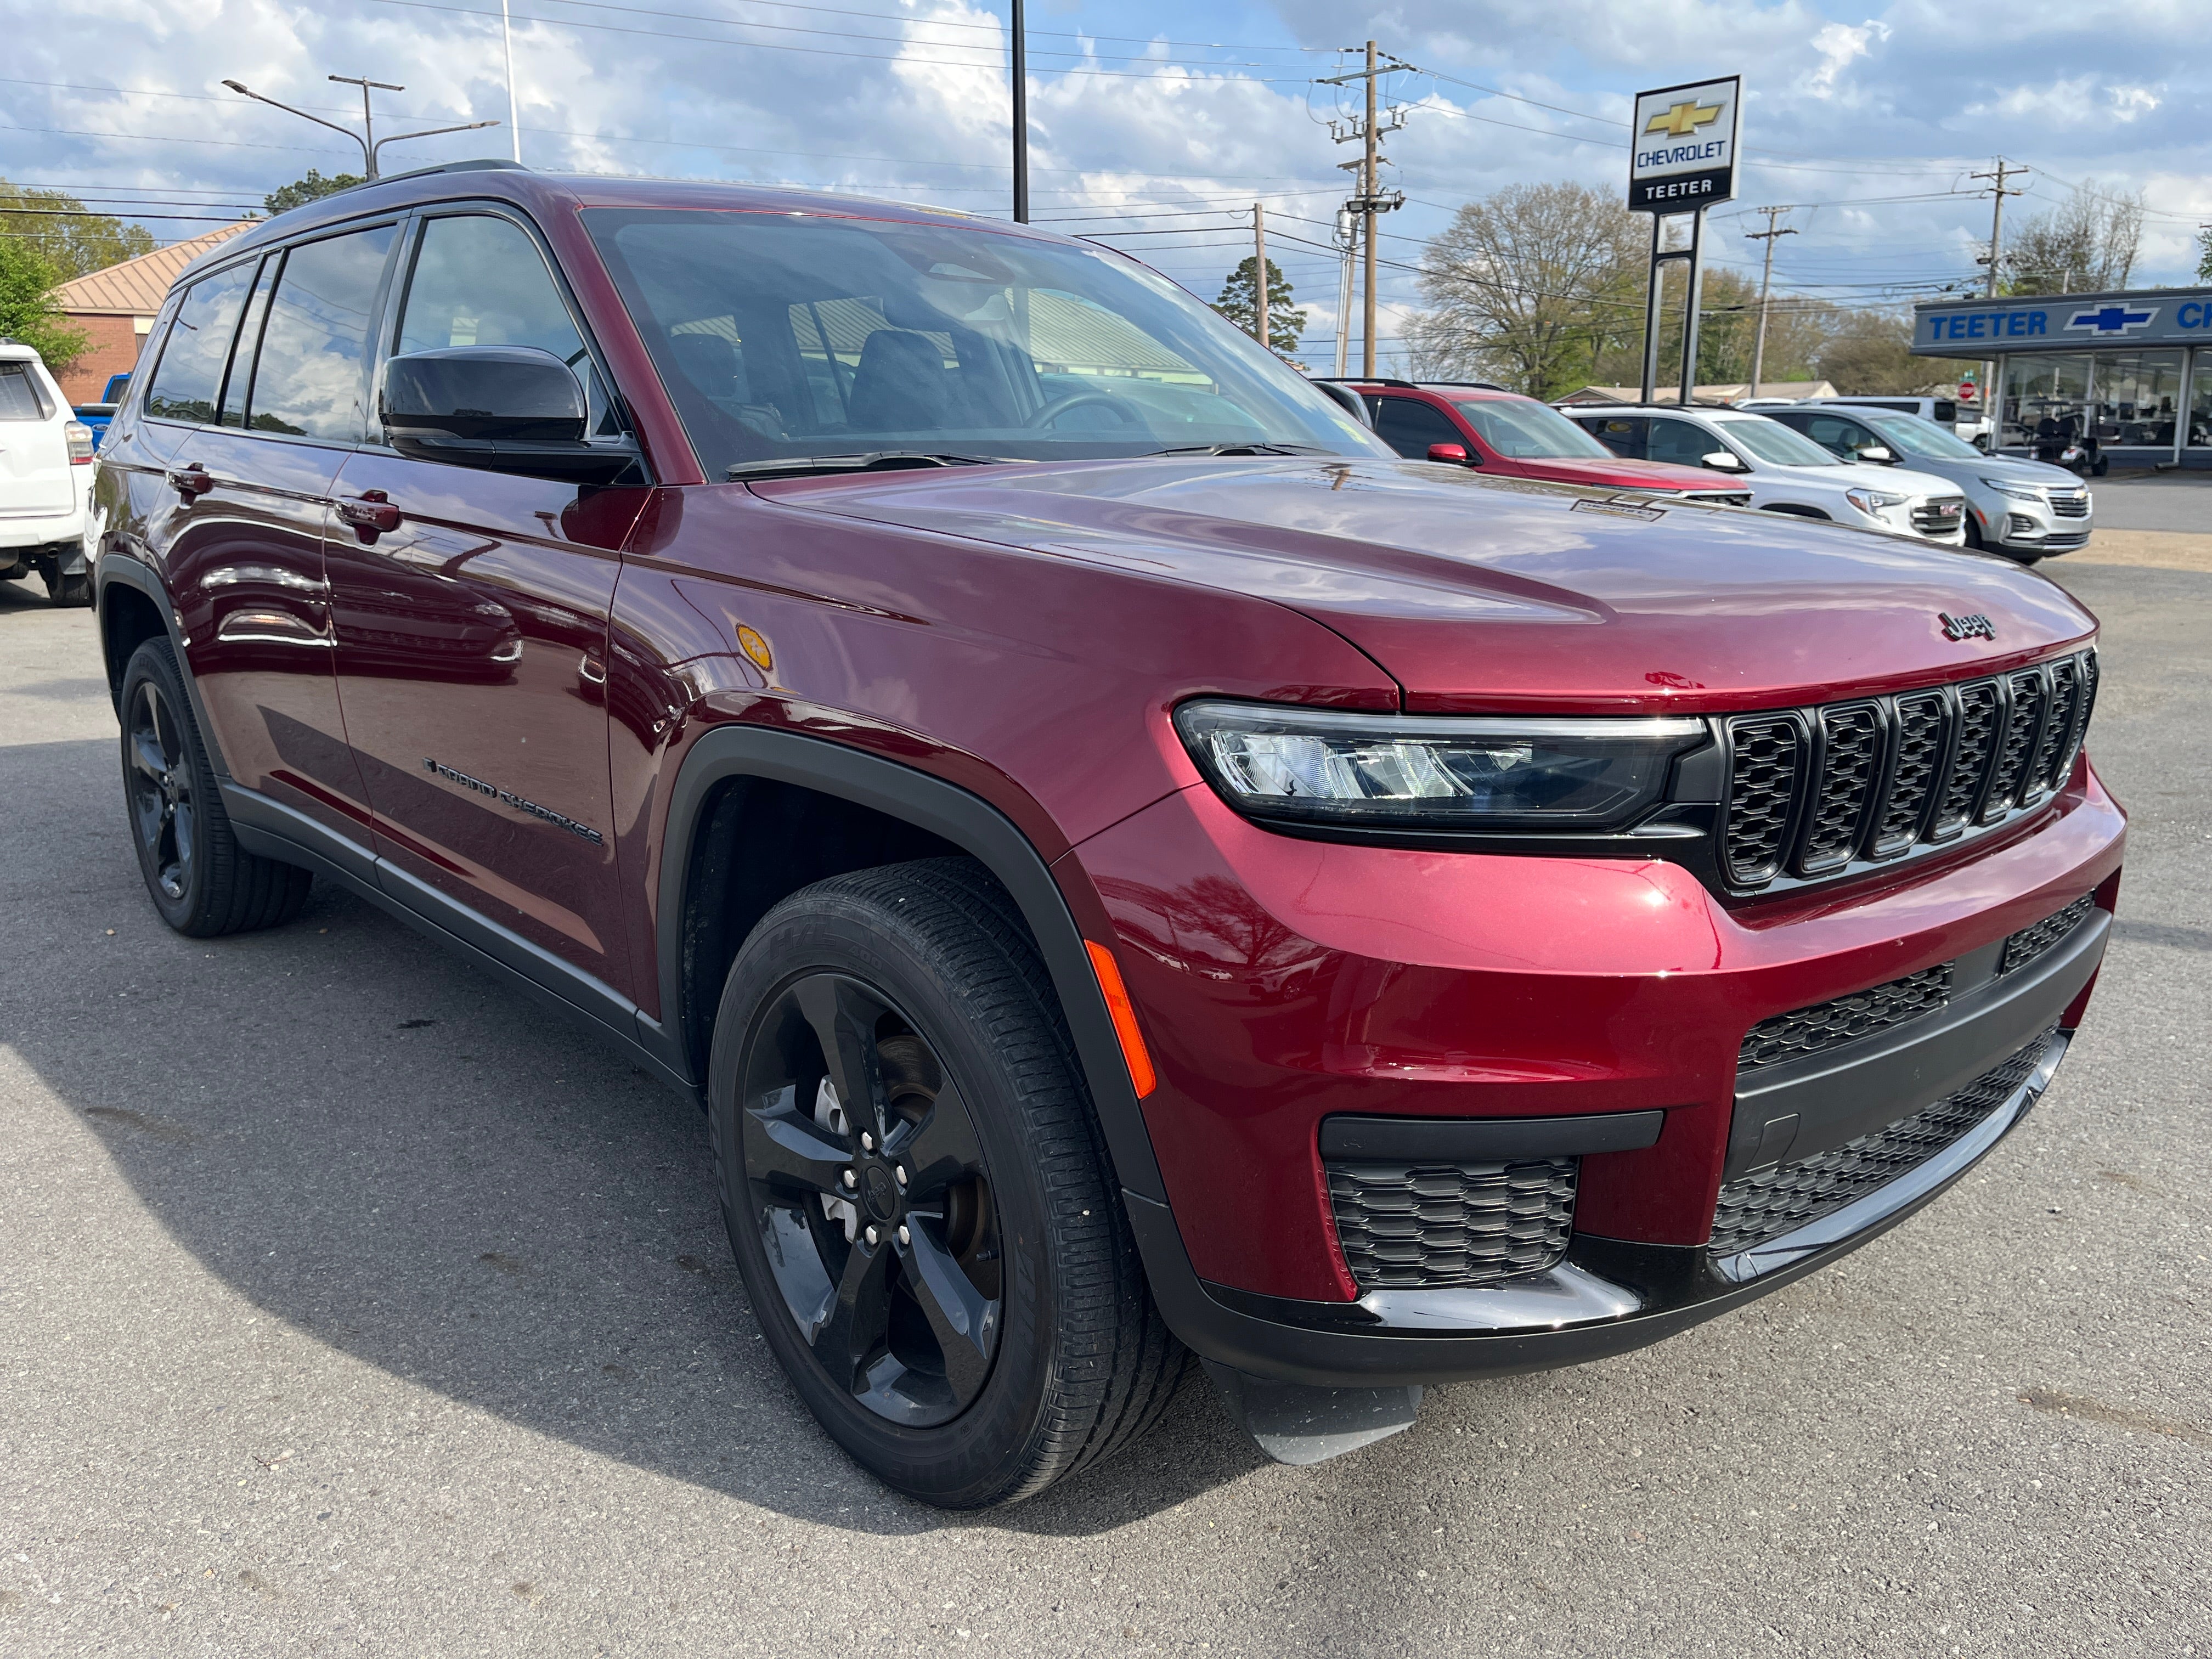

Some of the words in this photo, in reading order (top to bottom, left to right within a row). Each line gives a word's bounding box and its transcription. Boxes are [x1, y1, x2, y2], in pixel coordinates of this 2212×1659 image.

[1637, 140, 1726, 168] CHEVROLET
[1645, 179, 1712, 200] TEETER
[1929, 311, 2047, 340] TEETER
[1938, 612, 1996, 642] Jeep
[498, 790, 604, 847] CHEROKEE
[848, 945, 883, 970] 400
[867, 1181, 888, 1206] Jeep
